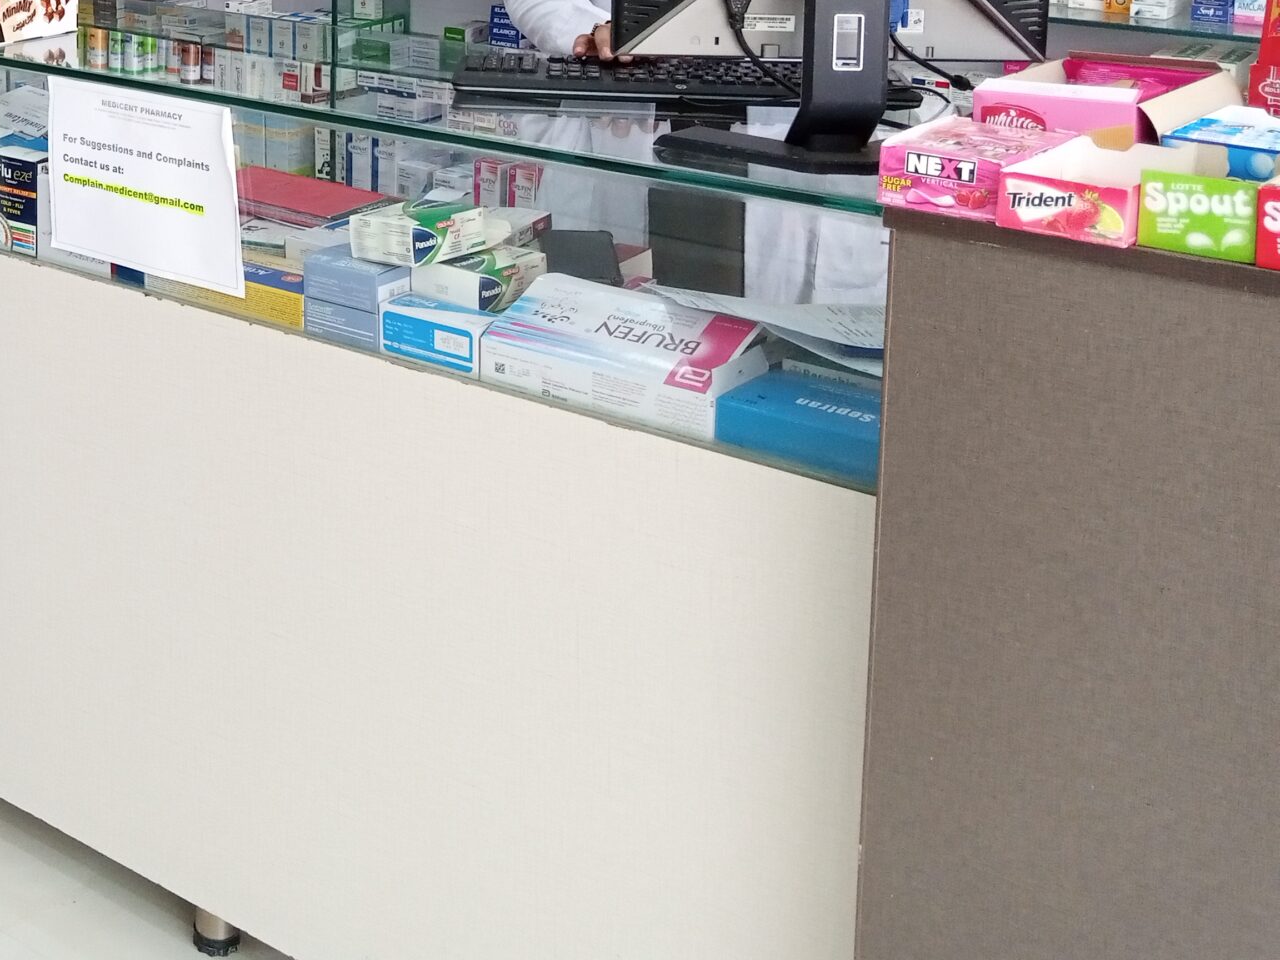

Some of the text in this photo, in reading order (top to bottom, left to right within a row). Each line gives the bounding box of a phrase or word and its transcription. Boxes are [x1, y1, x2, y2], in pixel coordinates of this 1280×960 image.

[101, 99, 138, 114] MEDICENT
[140, 106, 183, 121] PHARMACY
[63, 133, 211, 172] For Suggestions and Complaints
[63, 153, 124, 175] Contact us at:
[907, 153, 976, 183] NEXT
[63, 172, 205, 213] Complain.medicent@gmail.com
[882, 175, 912, 188] SUGAR
[882, 184, 902, 193] FREE
[921, 177, 959, 189] VERTICAL
[1170, 182, 1205, 192] LOTTE
[1006, 191, 1075, 210] Trident
[1145, 181, 1253, 216] Spout
[415, 237, 436, 250] Panadol
[481, 286, 502, 299] Panadol
[594, 319, 702, 357] BRUFEN
[795, 396, 876, 424] Septran
